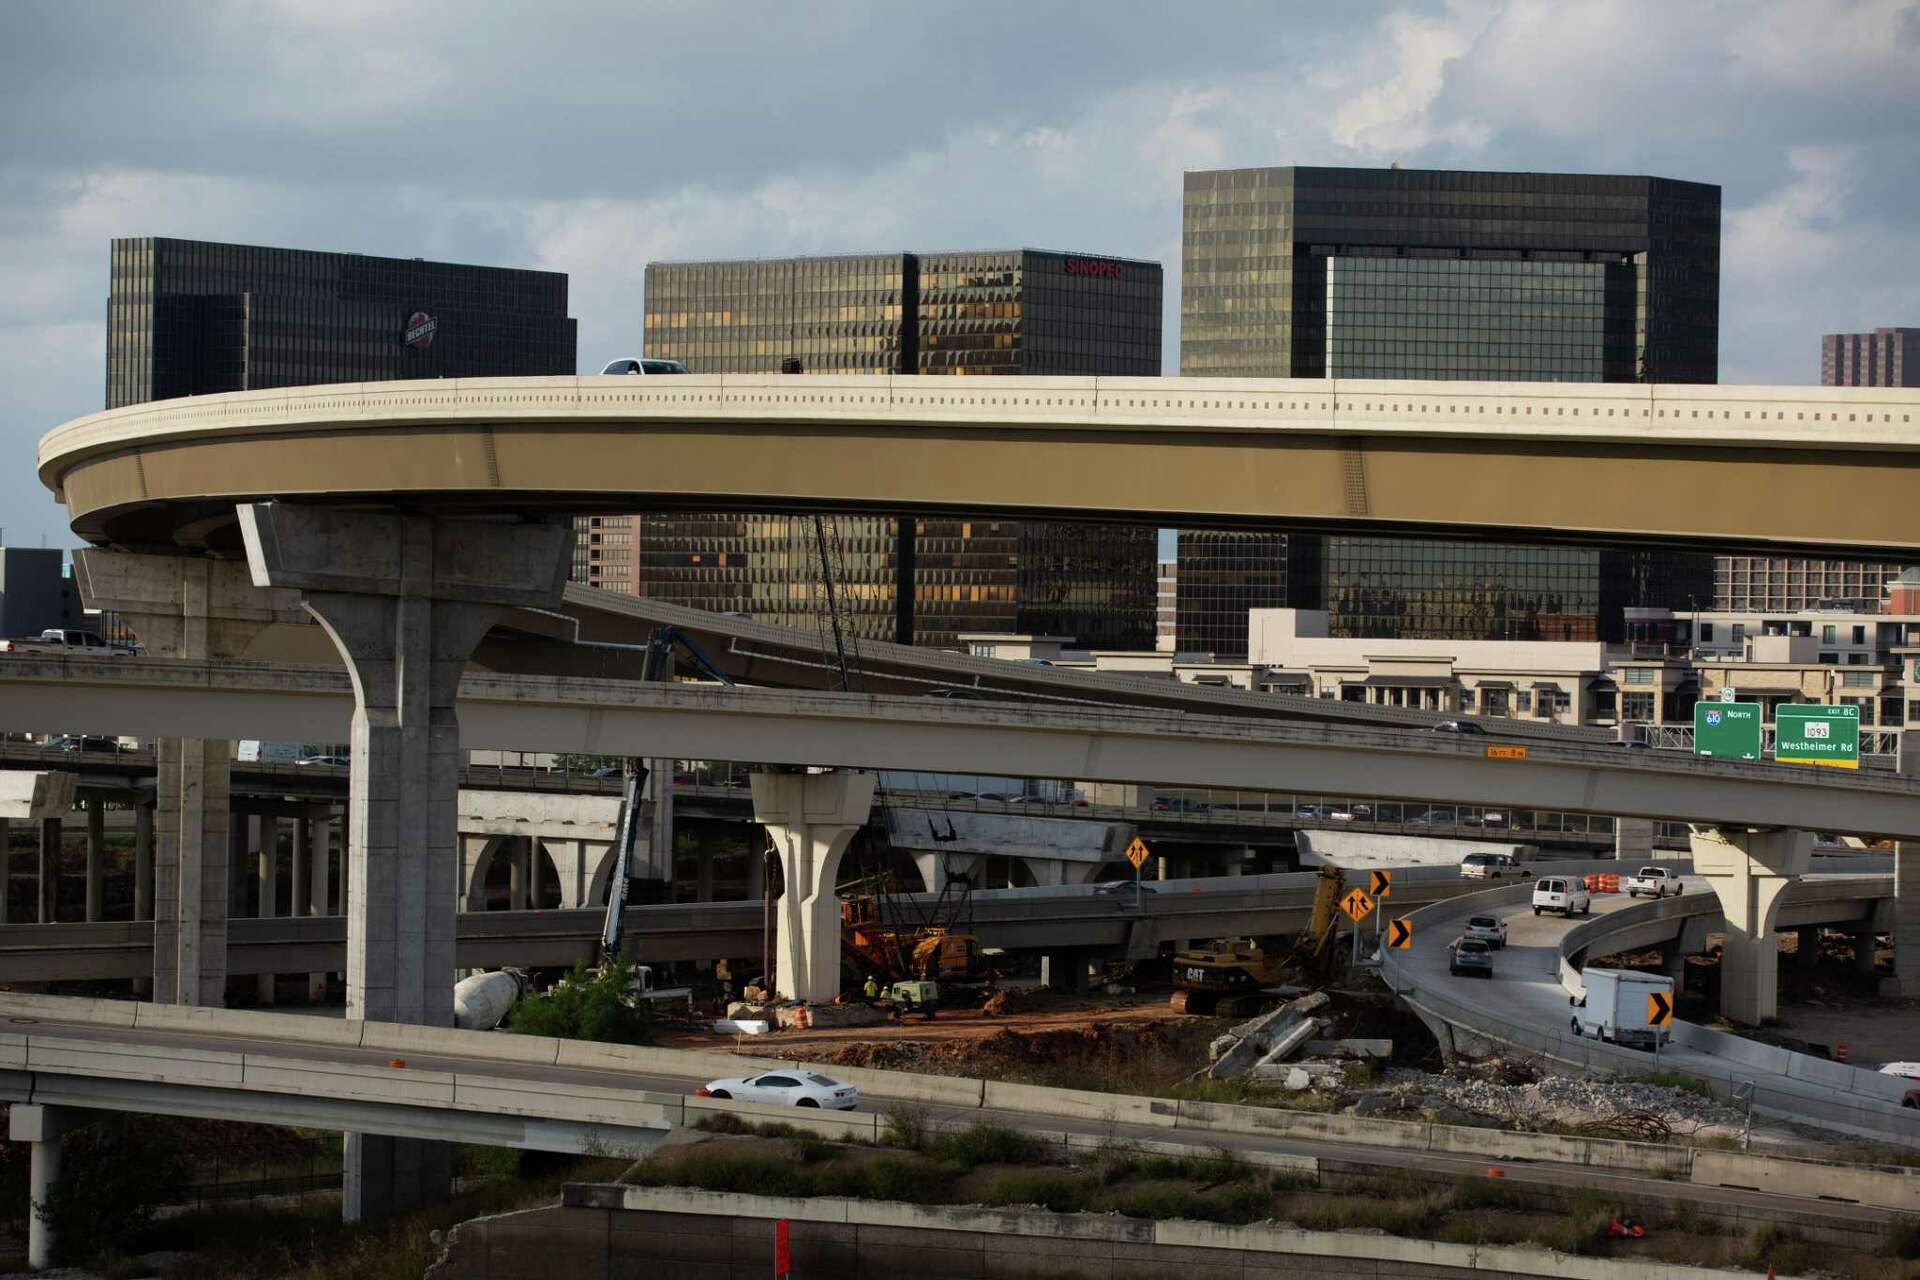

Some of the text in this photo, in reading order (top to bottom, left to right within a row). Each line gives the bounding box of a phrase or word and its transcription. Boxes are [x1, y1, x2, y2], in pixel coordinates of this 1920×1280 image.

[1066, 258, 1121, 277] SINOPEC
[1706, 710, 1751, 723] 610 NORTH
[1807, 728, 1827, 737] 1093
[1781, 741, 1853, 752] Westheimer Rd
[1187, 968, 1204, 982] CAT
